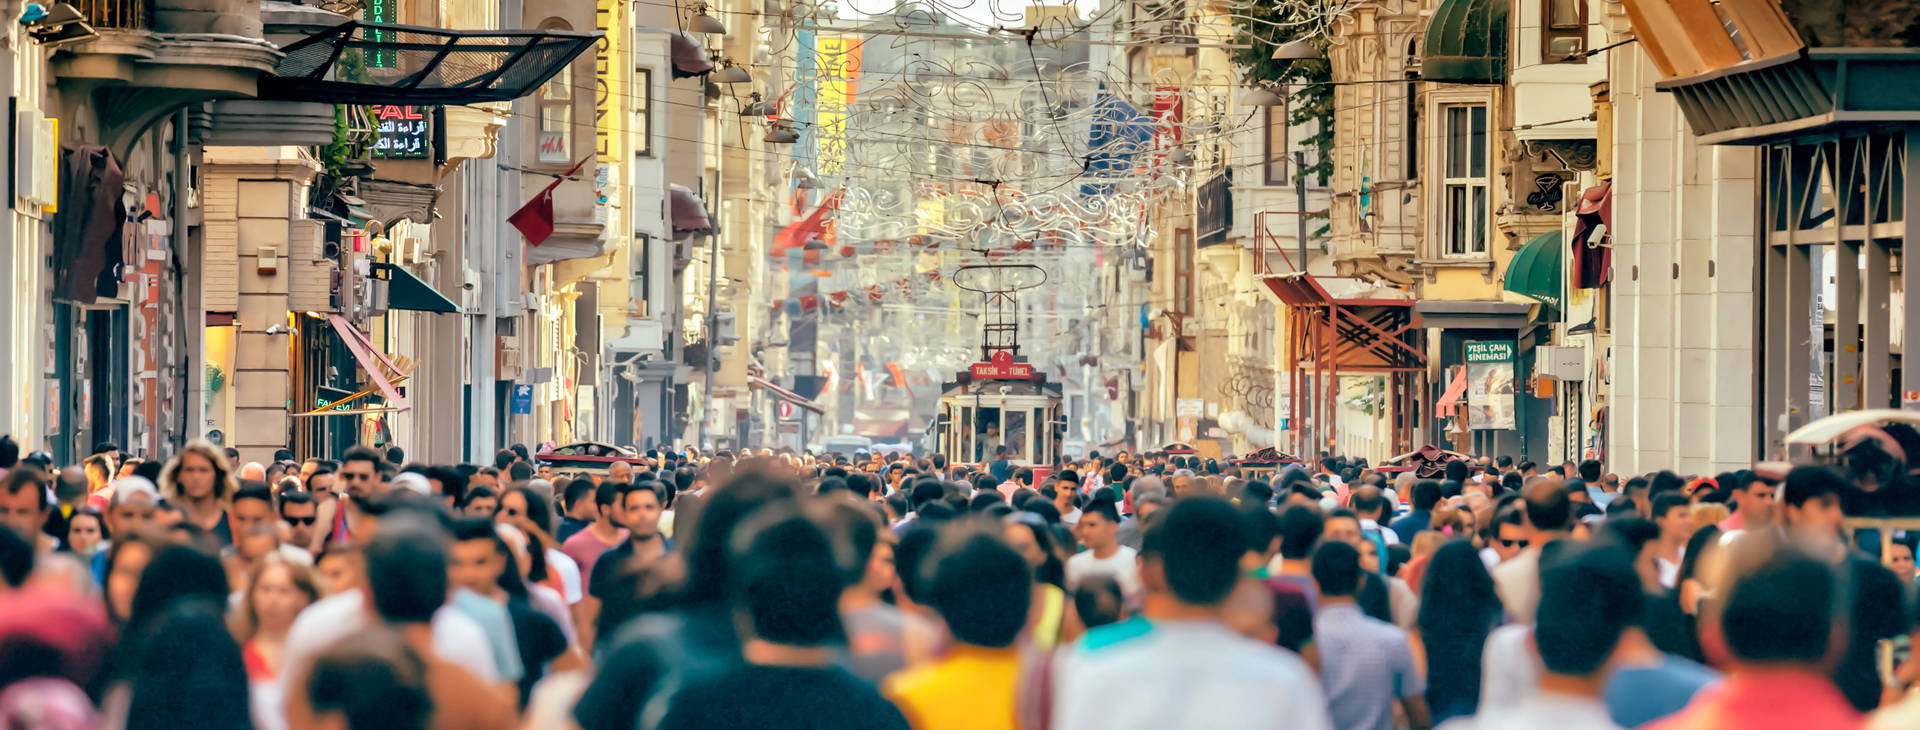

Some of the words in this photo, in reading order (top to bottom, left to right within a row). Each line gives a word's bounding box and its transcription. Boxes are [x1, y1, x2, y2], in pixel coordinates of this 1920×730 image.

[1467, 343, 1487, 354] YEŞİL
[1489, 343, 1507, 354] ÇAM
[1000, 352, 1005, 360] 2
[1468, 352, 1507, 361] SİNEMASI
[975, 365, 999, 376] TAKSİM
[1008, 366, 1030, 376] TÜNEL
